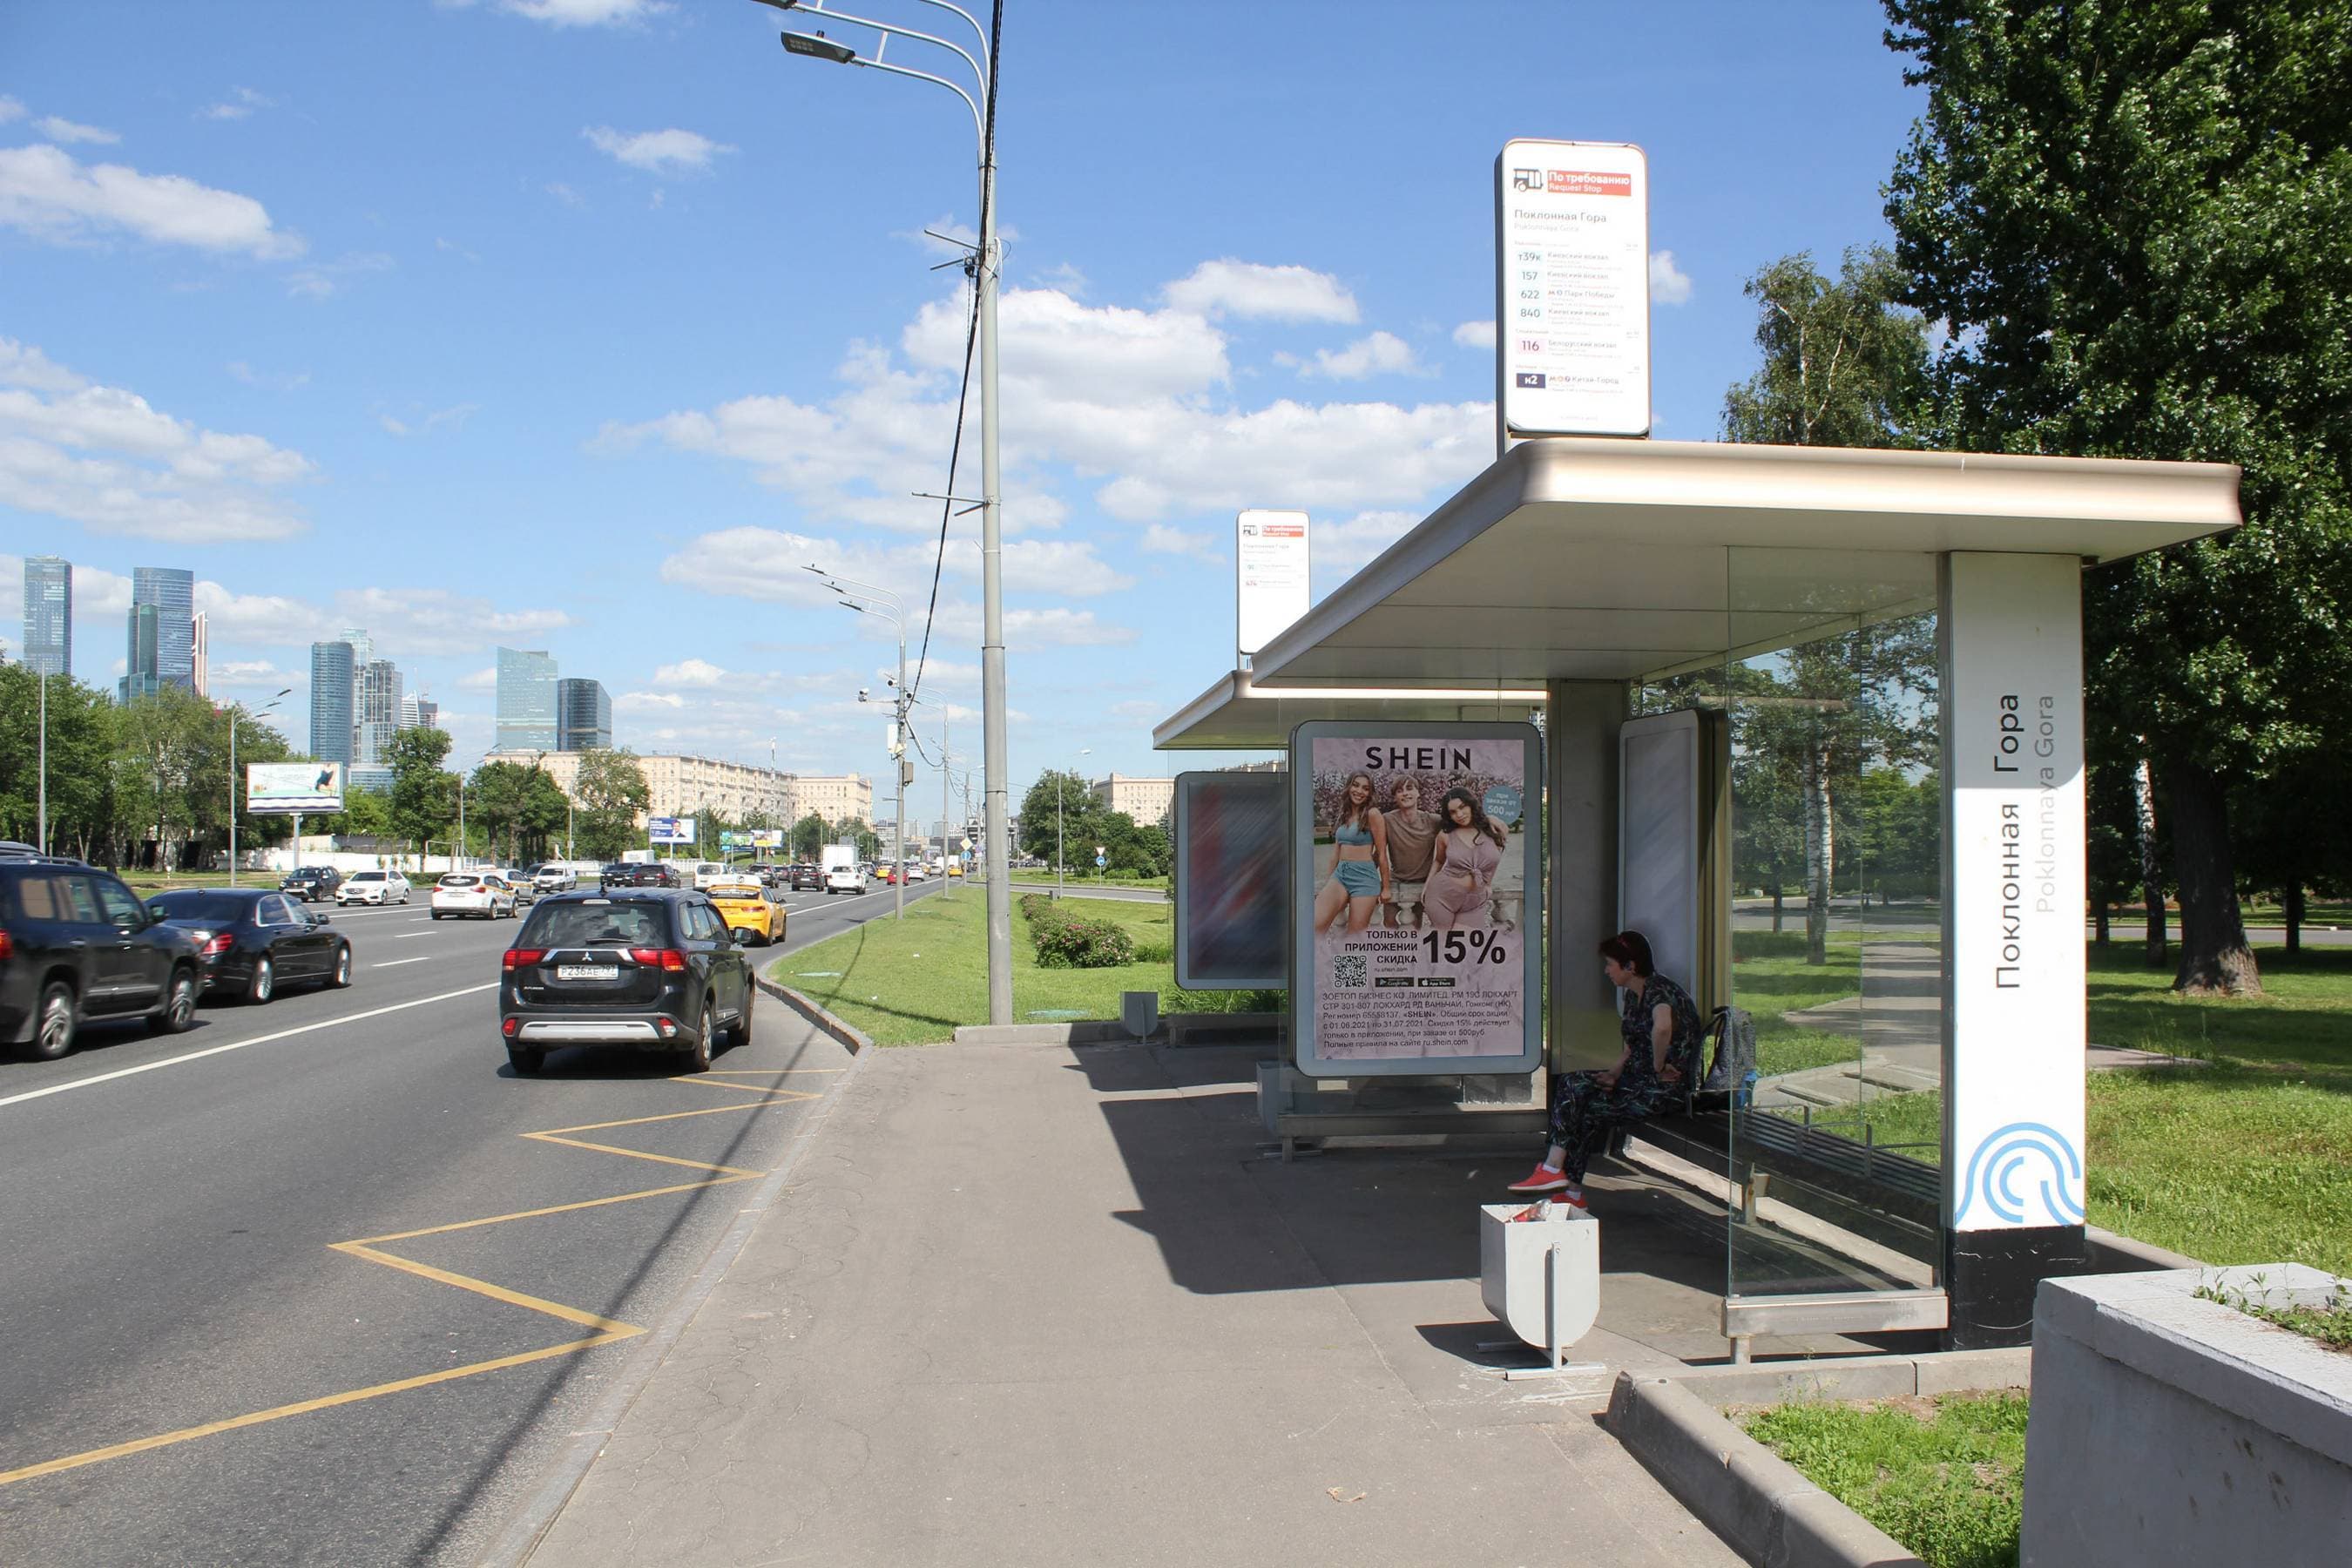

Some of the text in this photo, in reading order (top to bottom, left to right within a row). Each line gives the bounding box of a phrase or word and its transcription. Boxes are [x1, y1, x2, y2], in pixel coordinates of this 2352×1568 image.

[1549, 172, 1630, 186] По требованию
[1549, 183, 1602, 193] Request Stop
[1514, 209, 1607, 223] Поклонная Гора
[1518, 252, 1541, 262] т39к
[1521, 271, 1538, 280] 157
[1520, 289, 1540, 300] 622
[1520, 308, 1540, 318] 840
[1521, 340, 1540, 351] 116
[1365, 746, 1471, 770] SHEIN
[1487, 805, 1504, 814] 500
[2034, 695, 2058, 914] Poklonnaya Gora
[1994, 694, 2025, 989] Поклонная Гора
[1367, 930, 1417, 940] ТОЛЬКО В
[1345, 943, 1417, 952] ПРИЛОЖЕНИИ
[1422, 929, 1506, 964] 15%
[1376, 955, 1418, 964] СКИДКА
[1358, 991, 1392, 1000] БИЗНЕС
[1412, 1001, 1423, 1010] РД
[1468, 1010, 1484, 1019] срок
[1329, 1021, 1370, 1030] 01.06.2021
[1427, 1019, 1454, 1028] Скидка
[1473, 1019, 1511, 1028] действует
[1355, 1040, 1387, 1049] правила
